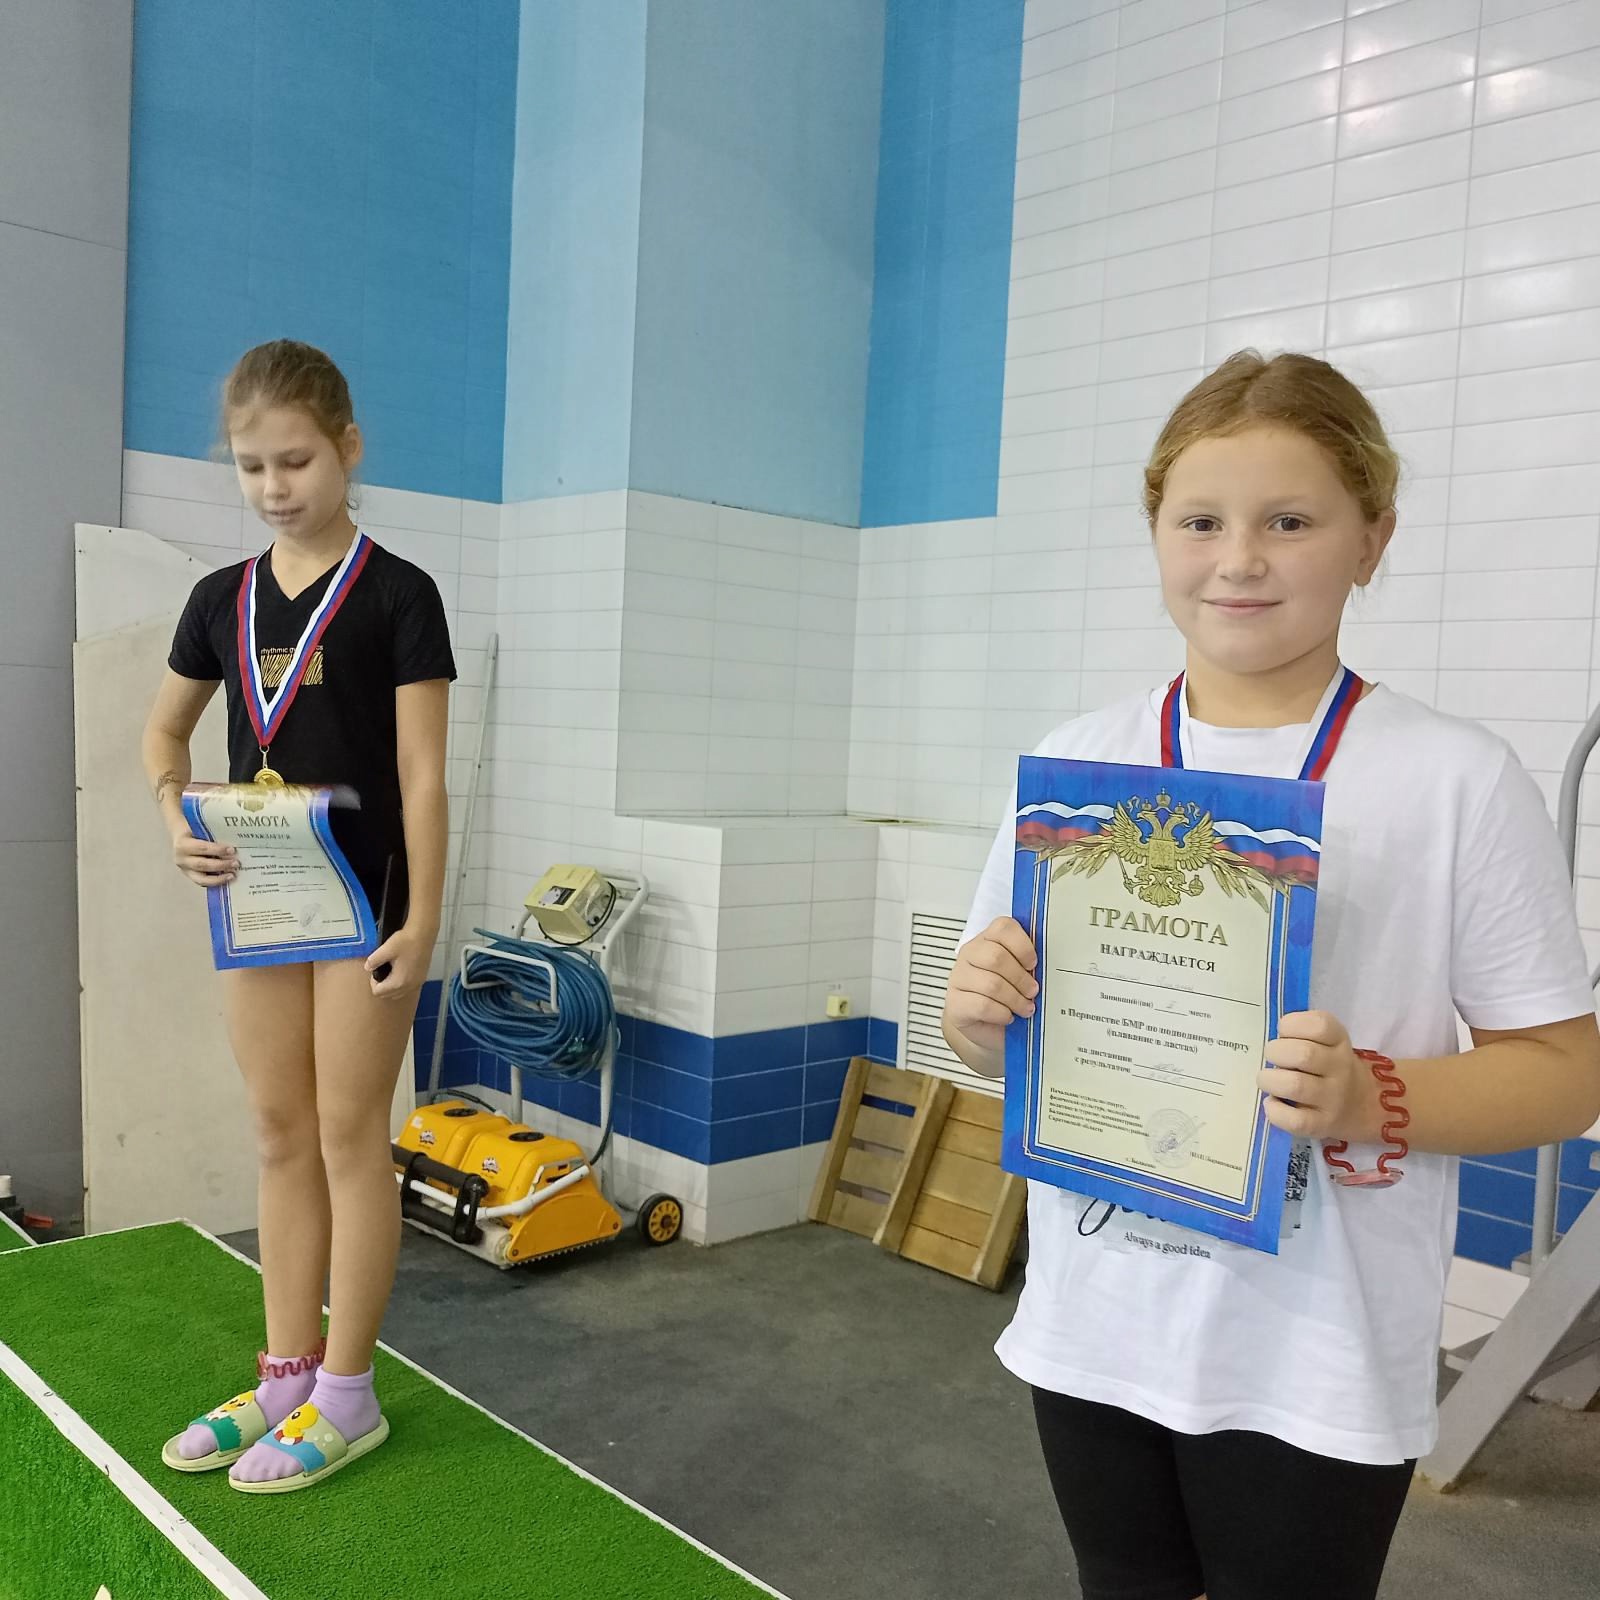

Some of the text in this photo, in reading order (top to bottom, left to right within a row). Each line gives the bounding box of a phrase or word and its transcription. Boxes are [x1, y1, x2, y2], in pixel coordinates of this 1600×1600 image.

[260, 646, 289, 656] rhythmic
[223, 815, 290, 828] ГРАМОТА
[1089, 906, 1229, 947] ГРАМОТА
[1100, 943, 1216, 973] НАГРАЖДАЕТСЯ
[1068, 1008, 1121, 1026] Первенстве
[1122, 1018, 1145, 1031] БМР
[1147, 1024, 1158, 1033] по
[1159, 1026, 1214, 1046] подводному
[1217, 1039, 1250, 1053] спорту
[1123, 1230, 1212, 1259] Always a good idea
